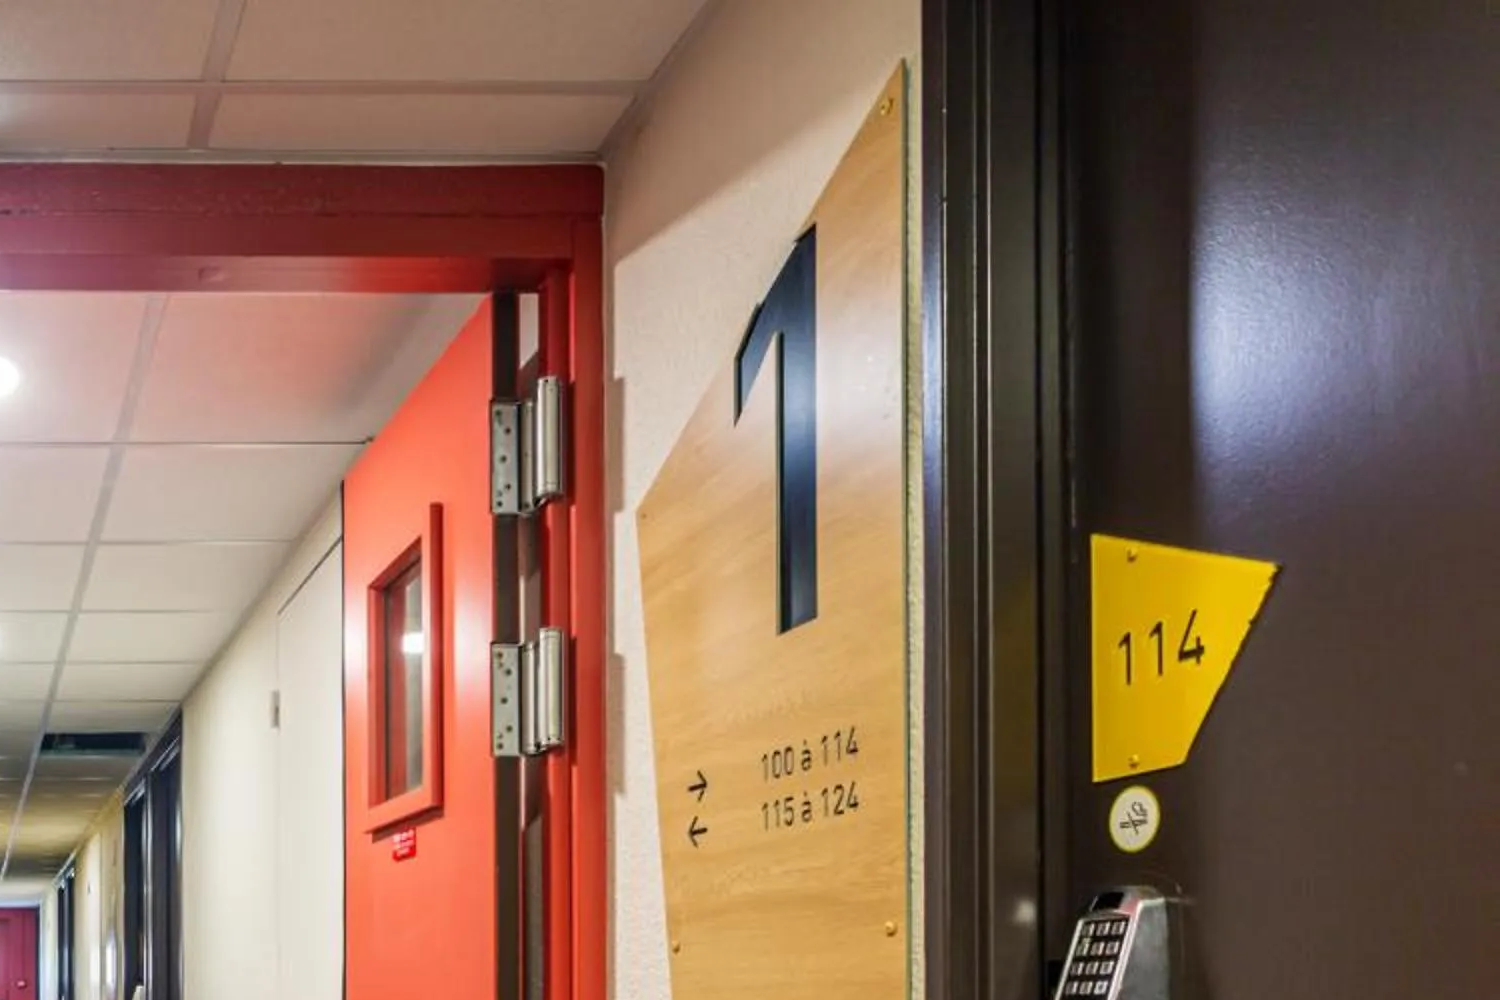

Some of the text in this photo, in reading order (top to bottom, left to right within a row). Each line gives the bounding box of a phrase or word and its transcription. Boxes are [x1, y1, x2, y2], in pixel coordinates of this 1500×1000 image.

[734, 222, 817, 635] 1
[1118, 608, 1205, 686] 114
[761, 725, 859, 783] 100 à 114
[761, 781, 860, 832] 115 à 124
